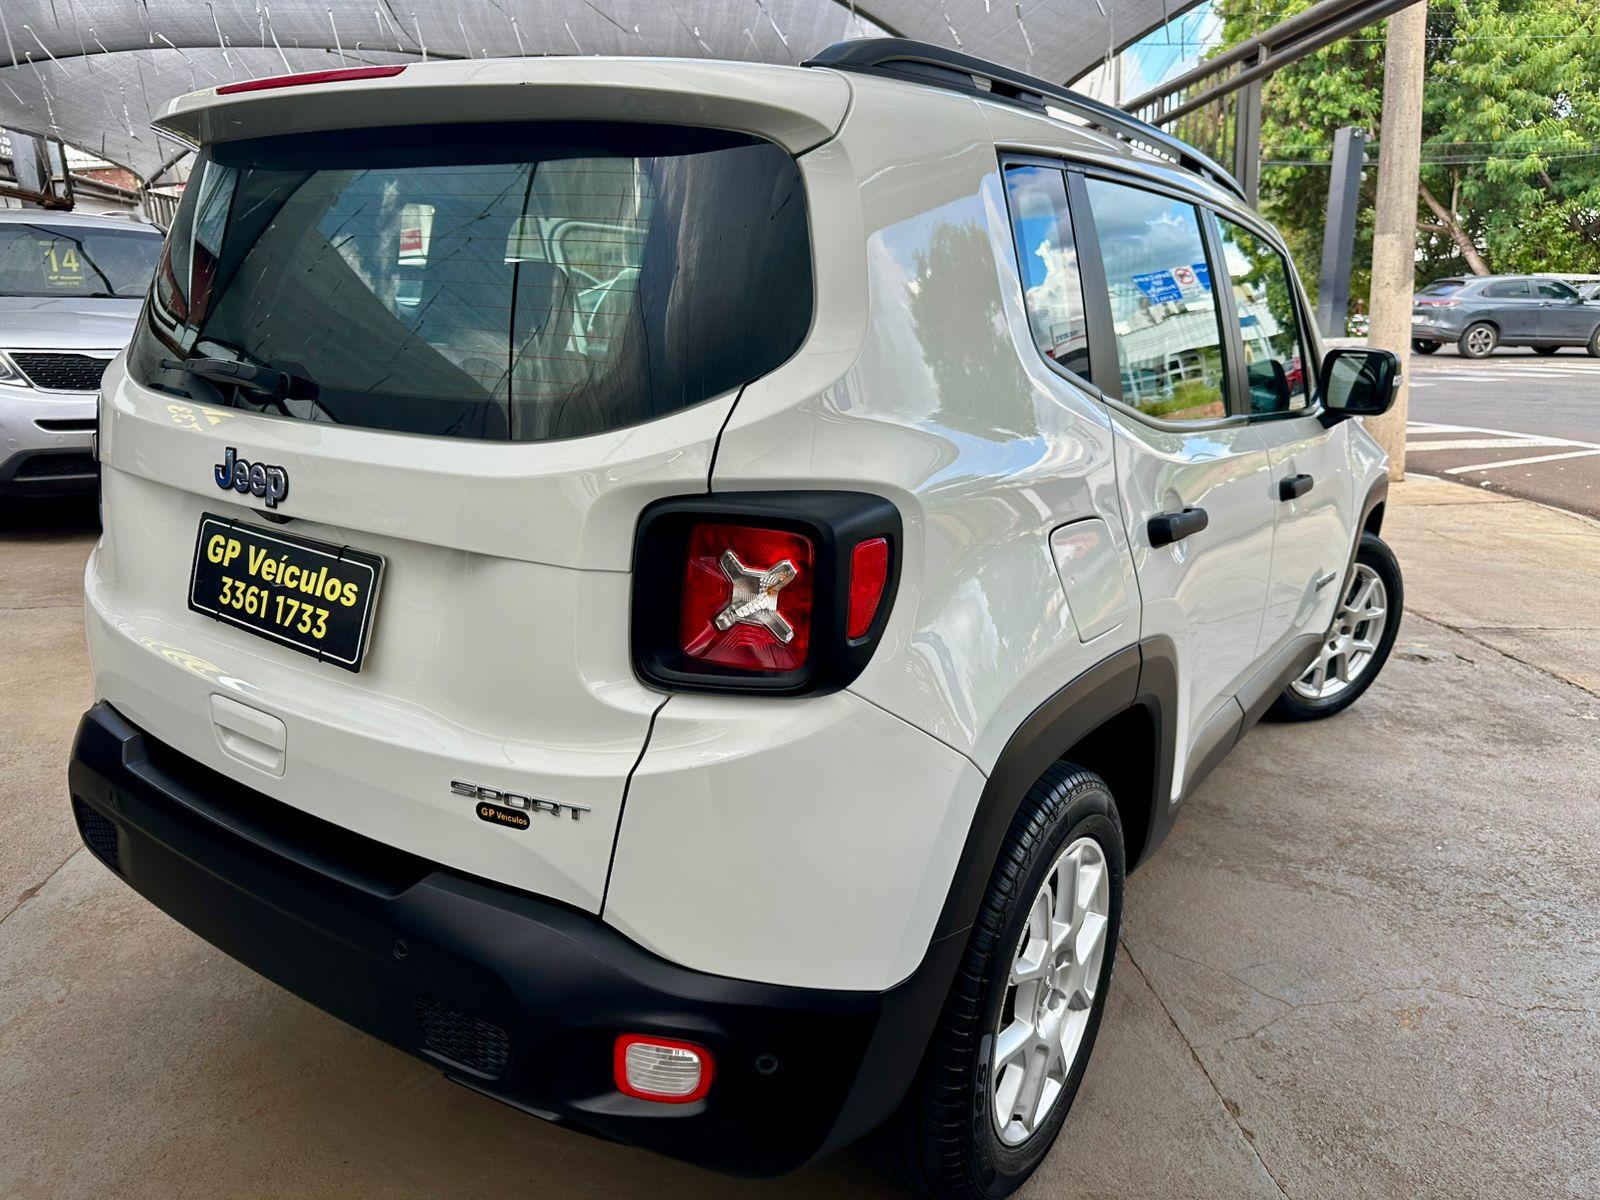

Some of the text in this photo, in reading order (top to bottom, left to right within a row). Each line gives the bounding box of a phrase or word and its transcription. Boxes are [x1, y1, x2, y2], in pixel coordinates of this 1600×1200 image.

[43, 248, 79, 272] 14
[214, 447, 289, 508] Jeep
[207, 534, 358, 607] GP Veículos
[218, 576, 330, 639] 3361 1733
[450, 779, 591, 821] SPORT
[481, 807, 495, 817] GP
